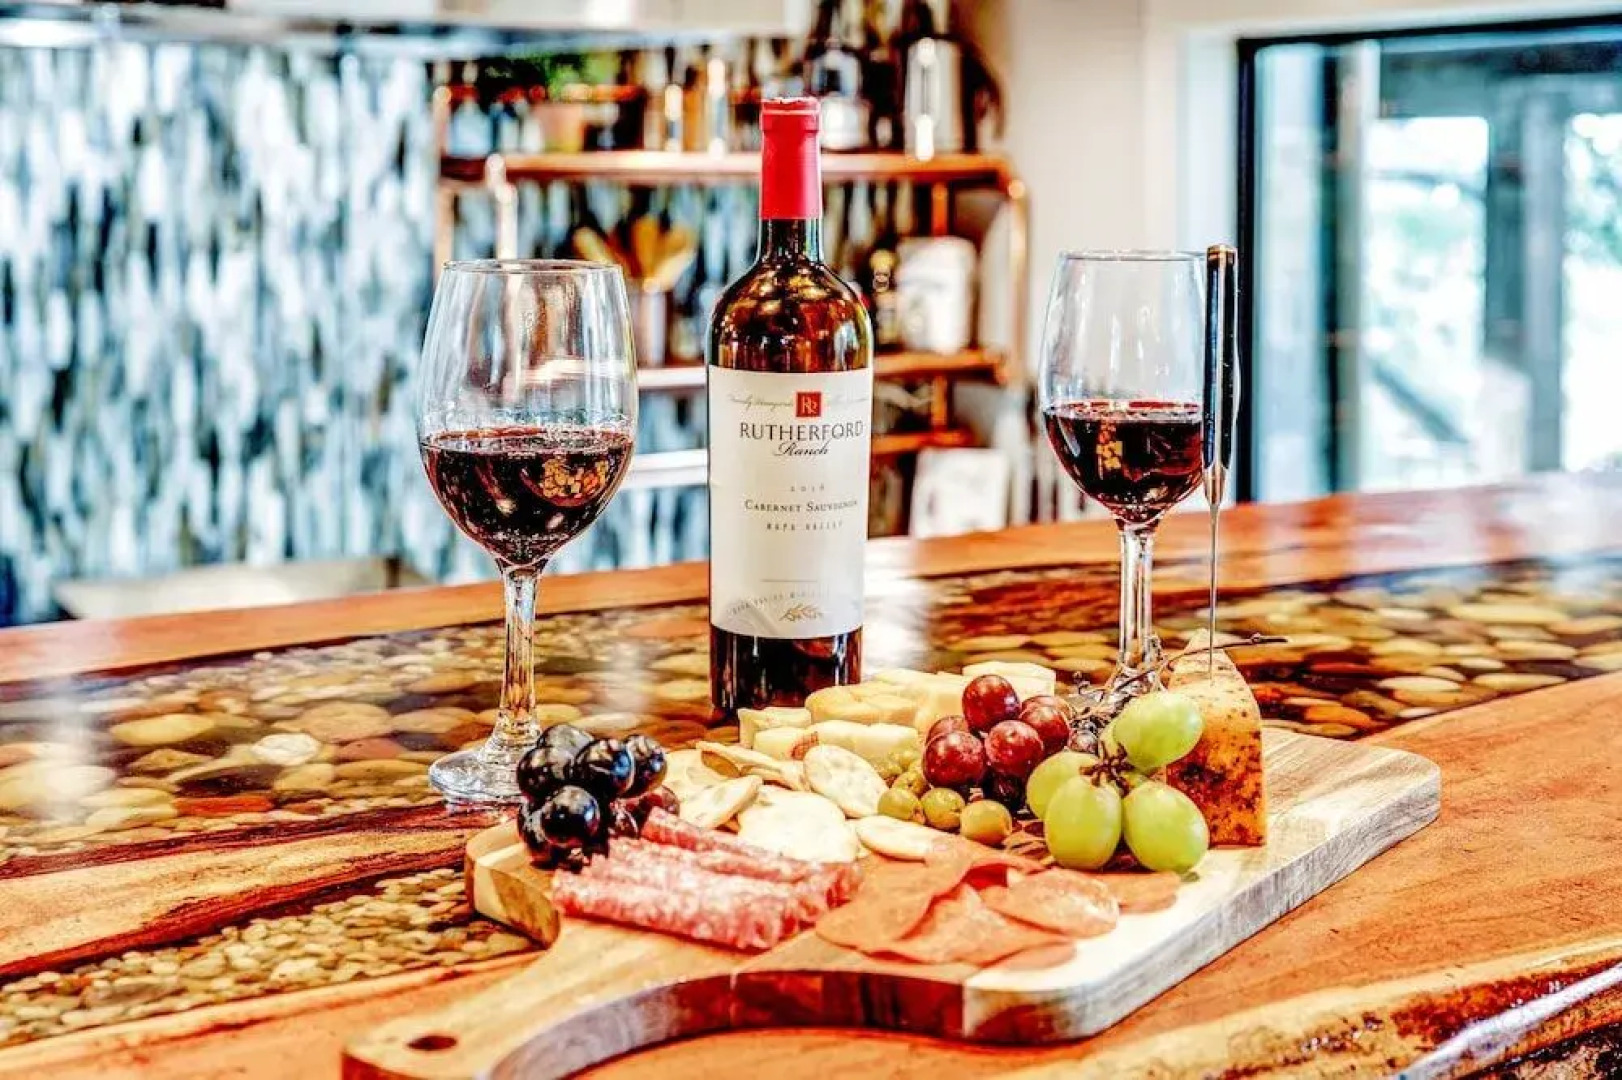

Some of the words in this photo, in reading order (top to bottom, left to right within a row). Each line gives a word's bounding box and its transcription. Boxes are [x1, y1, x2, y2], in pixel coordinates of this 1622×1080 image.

[739, 420, 864, 441] RUTHERFORD
[774, 441, 829, 457] Ranch
[744, 499, 801, 513] CABERNET
